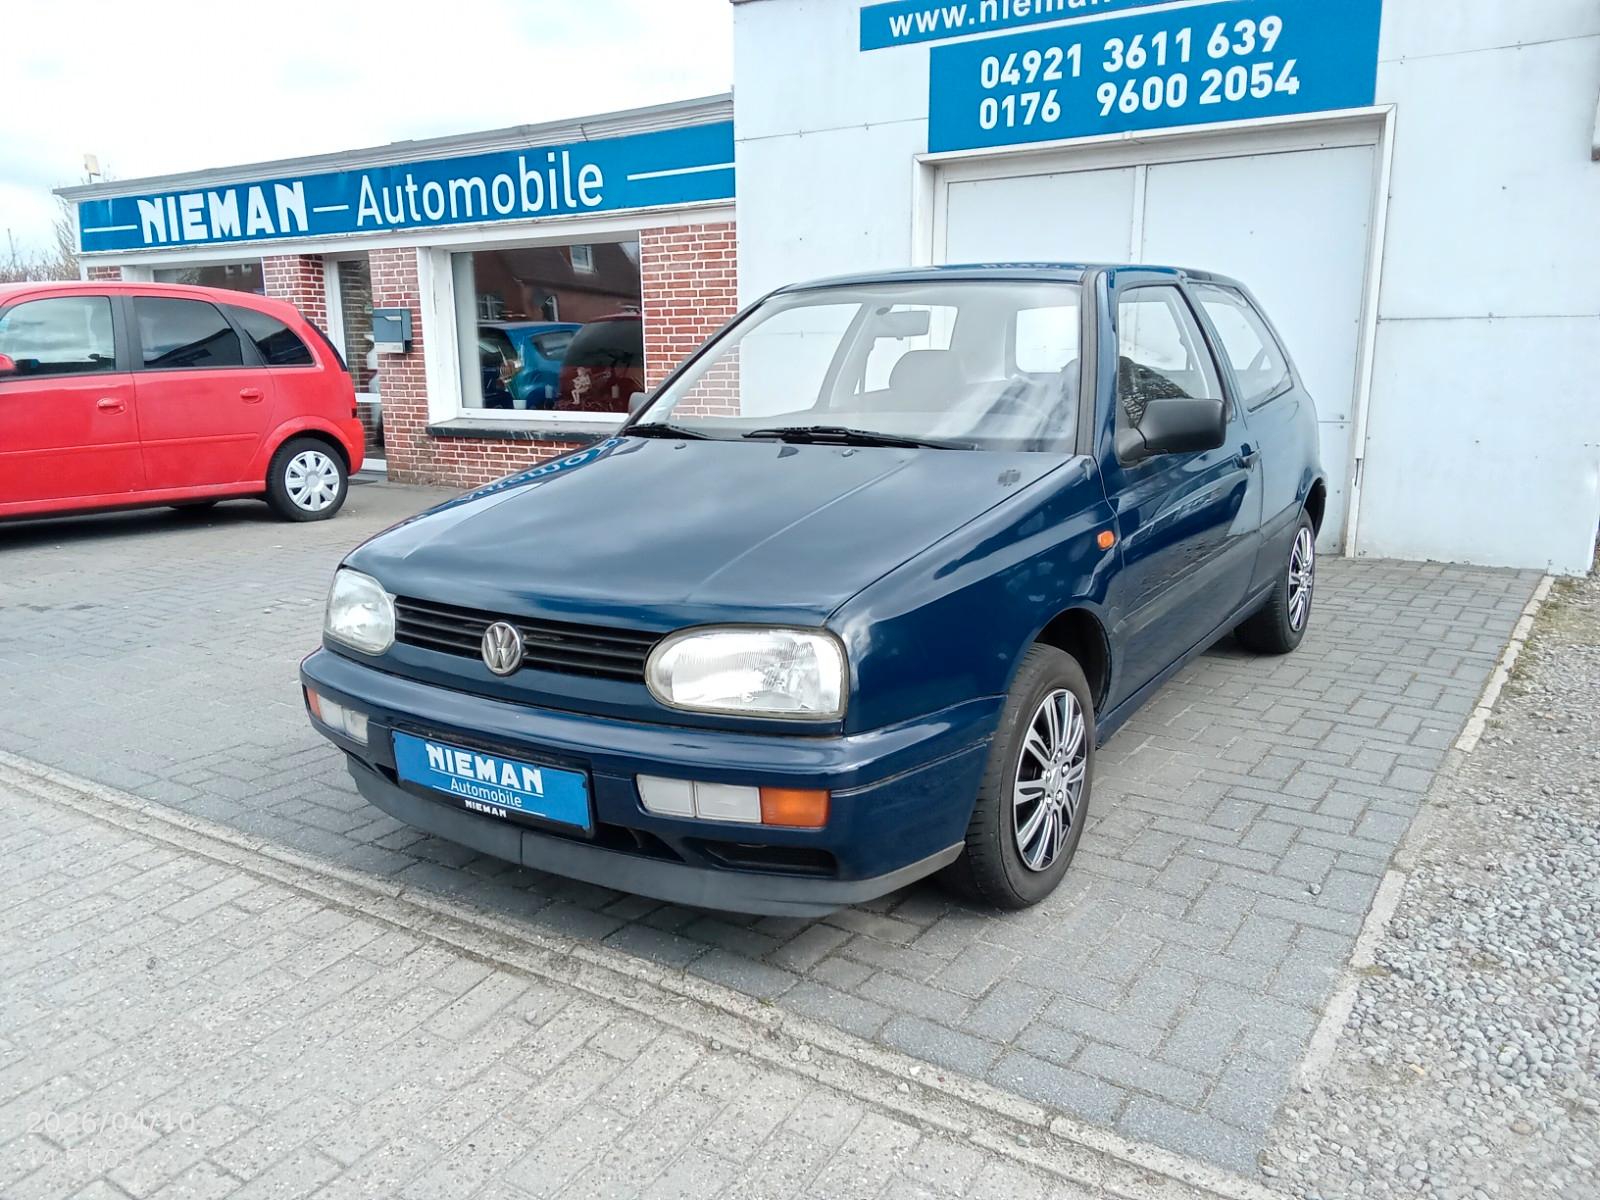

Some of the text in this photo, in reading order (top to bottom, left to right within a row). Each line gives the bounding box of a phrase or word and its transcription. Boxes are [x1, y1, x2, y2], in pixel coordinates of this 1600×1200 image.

[889, 0, 1110, 37] www.niem
[981, 16, 1283, 89] 04921 3611 639
[979, 60, 1300, 130] 0176 9600 2054
[137, 151, 604, 244] NIEMAN Automobile
[425, 743, 544, 793] NIEMAN
[450, 778, 522, 807] Automobile
[465, 800, 507, 818] NIEMAN
